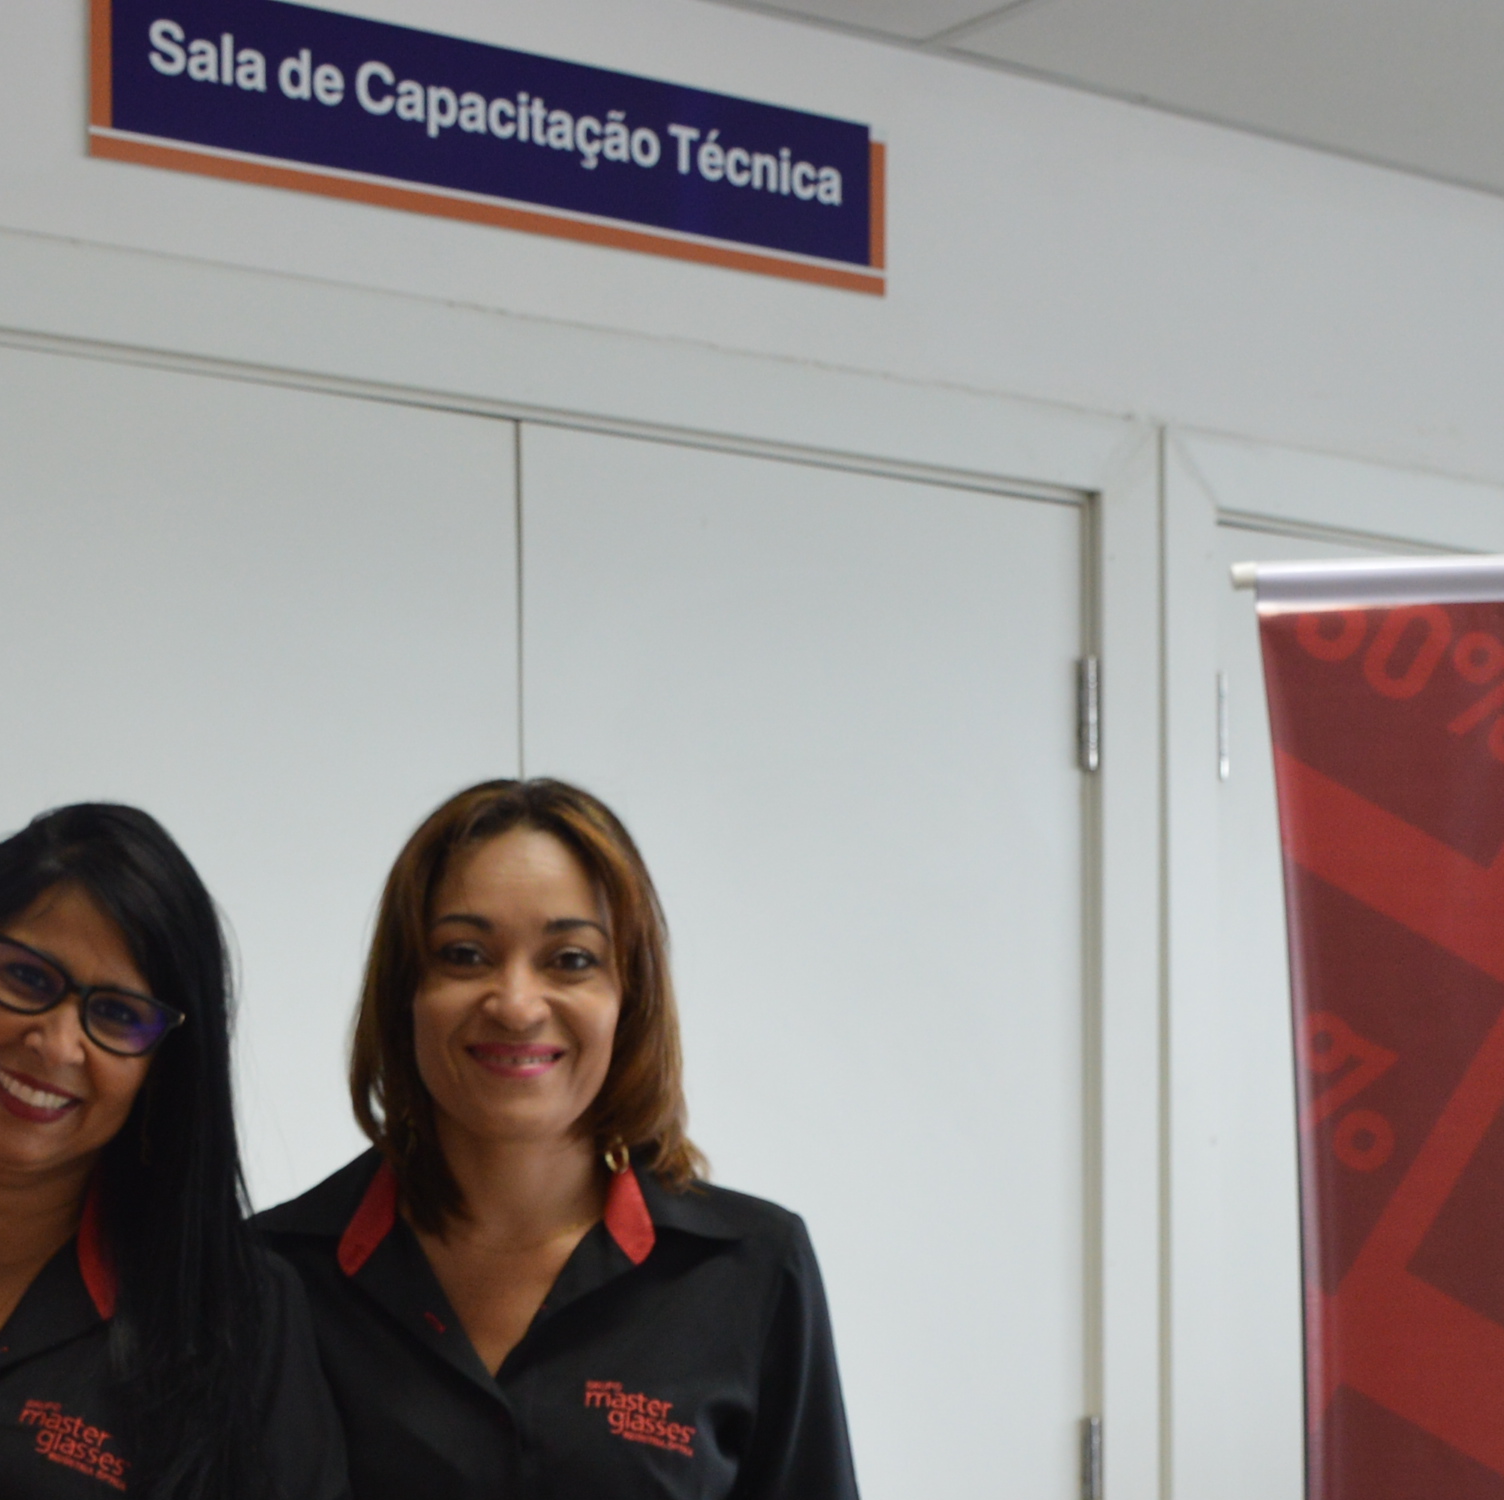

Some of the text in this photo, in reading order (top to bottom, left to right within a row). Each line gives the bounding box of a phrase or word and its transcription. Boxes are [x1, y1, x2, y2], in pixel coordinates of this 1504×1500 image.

[148, 18, 844, 206] Sala de Capacitação Técnica
[584, 1390, 673, 1418] master
[18, 1408, 112, 1446] master
[608, 1408, 696, 1445] glasses
[35, 1429, 125, 1476] glasses
